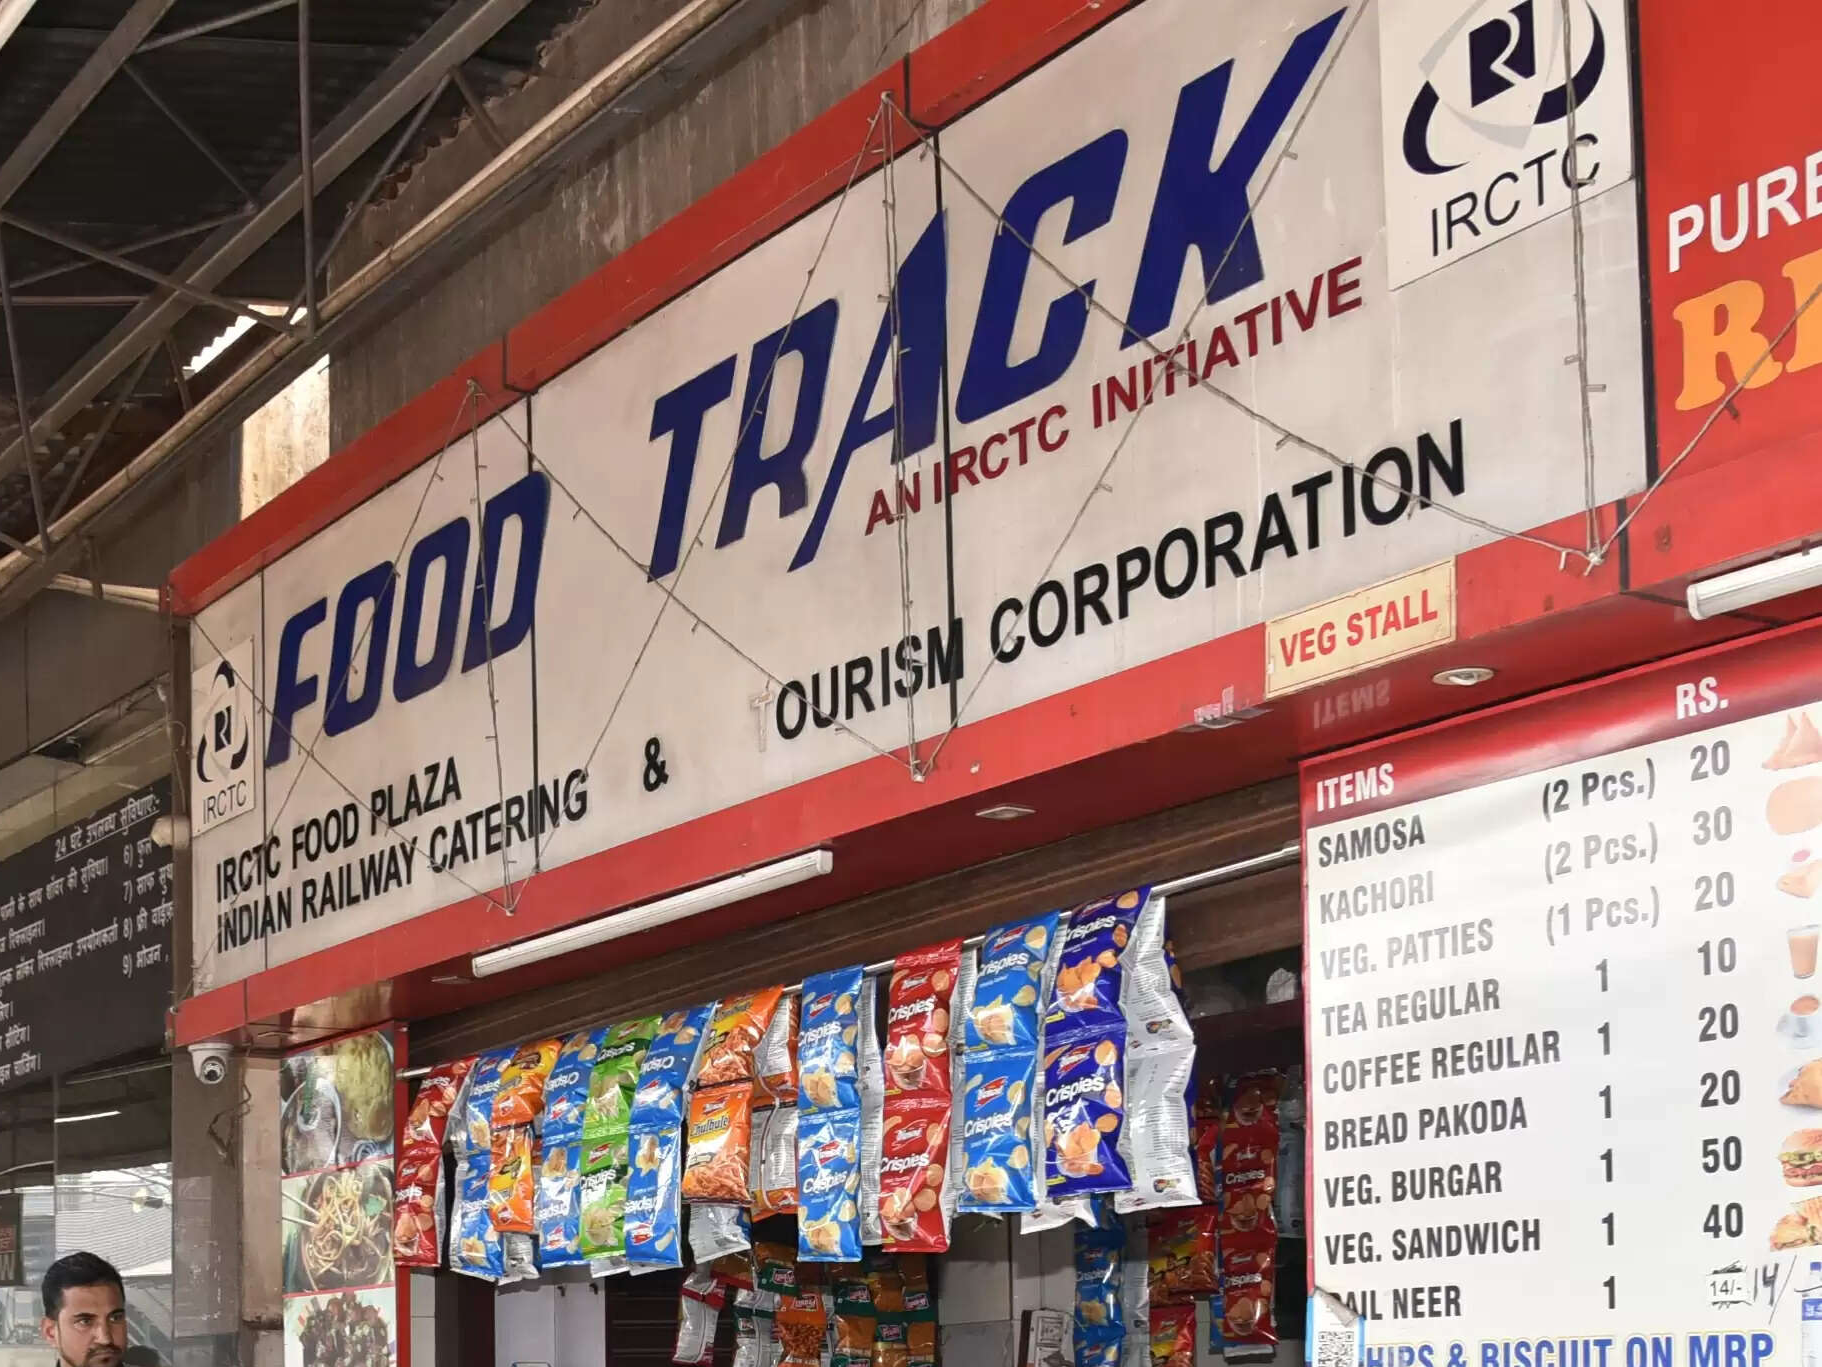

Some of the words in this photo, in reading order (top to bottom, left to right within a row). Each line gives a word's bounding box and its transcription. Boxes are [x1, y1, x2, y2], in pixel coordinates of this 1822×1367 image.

[1431, 133, 1600, 257] IRCTC
[266, 470, 551, 771] FOOD
[647, 6, 1346, 582] TRACK
[865, 470, 921, 535] AN
[932, 406, 1069, 505] IRCTC
[1091, 257, 1362, 428] INITIATIVE
[1279, 623, 1337, 667] VEG
[1346, 589, 1438, 647] STALL
[216, 889, 292, 954] INDIAN
[301, 836, 417, 920] RAILWAY
[429, 769, 588, 875] CATERING
[643, 736, 668, 792] &
[989, 420, 1465, 664] CORPORATION
[1315, 763, 1395, 813] ITEMS
[1676, 675, 1730, 722] RS.
[202, 779, 248, 823] IRCTC
[216, 836, 280, 903] IRCTC
[292, 802, 360, 870] FOOD
[371, 756, 462, 835] PLAZA
[1318, 815, 1426, 868] SAMOSA
[1542, 780, 1571, 824] (2
[1581, 757, 1657, 807] Pcs.)
[1690, 739, 1731, 782] 20
[1320, 869, 1434, 925] KACHORI
[1543, 843, 1572, 885] (2
[1583, 822, 1660, 870] Pcs.)
[1692, 805, 1733, 847] 30
[1321, 941, 1376, 981] VEG.
[1386, 917, 1495, 972] PATTIES
[1545, 905, 1572, 947] (1
[1584, 885, 1661, 934] Pcs.)
[1693, 870, 1735, 912] 20
[1321, 999, 1368, 1039] TEA
[1375, 978, 1501, 1030] REGULAR
[1595, 959, 1609, 993] 1
[1697, 937, 1737, 977] 10
[1045, 1075, 1105, 1106] Crispies
[1323, 1049, 1421, 1094] COFFEE
[1431, 1030, 1560, 1074] REGULAR
[1597, 1022, 1611, 1056] 1
[1698, 1003, 1739, 1042] 20
[964, 1112, 1012, 1138] Crispies
[1324, 1109, 1408, 1151] BREAD
[1419, 1097, 1528, 1141] PAKODA
[1599, 1085, 1612, 1119] 1
[1700, 1069, 1740, 1107] 20
[1324, 1176, 1381, 1208] VEG.
[1391, 1160, 1503, 1202] BURGAR
[1599, 1148, 1614, 1182] 1
[1702, 1135, 1743, 1172] 50
[1325, 1232, 1382, 1265] VEG.
[1392, 1218, 1541, 1262] SANDWICH
[1601, 1212, 1615, 1246] 1
[1702, 1202, 1744, 1239] 40
[1329, 1292, 1383, 1322] AIL
[1393, 1285, 1462, 1318] NEER
[1602, 1275, 1617, 1309] 1
[1710, 1280, 1742, 1296] 14/-
